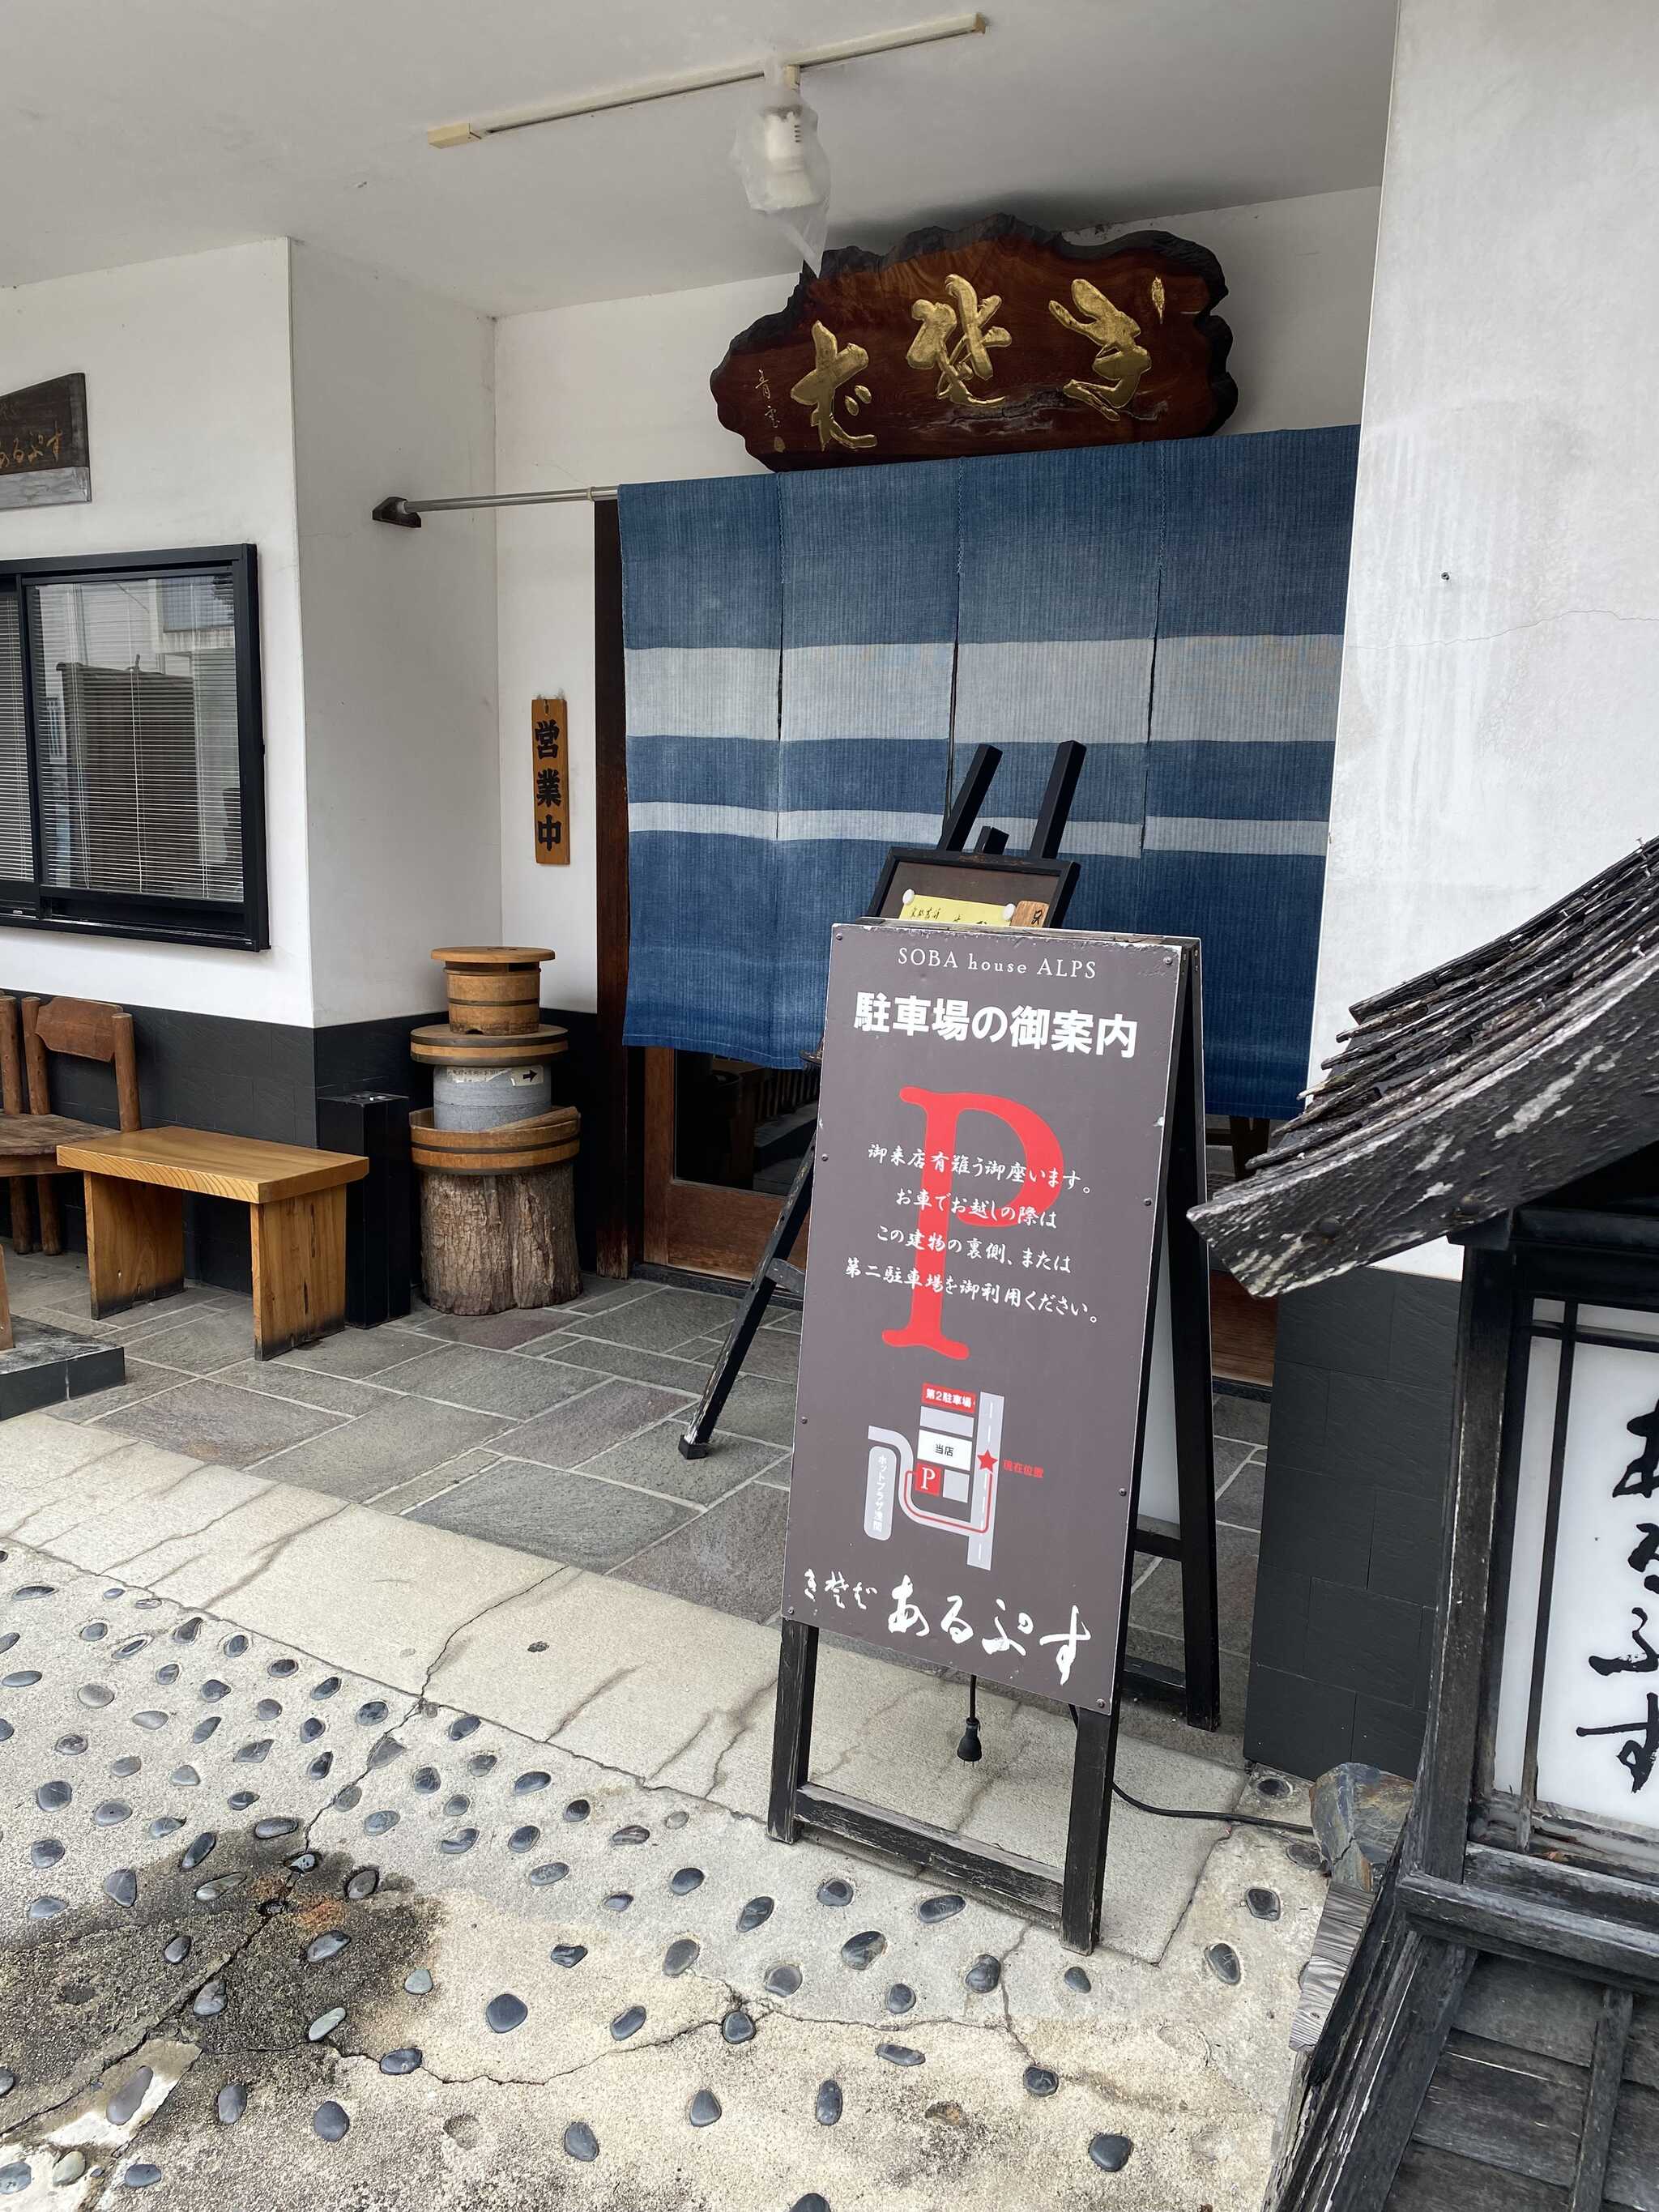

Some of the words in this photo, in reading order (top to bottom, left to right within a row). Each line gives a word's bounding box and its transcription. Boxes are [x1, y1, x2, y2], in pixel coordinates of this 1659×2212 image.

[535, 718, 561, 851] 営業中
[898, 948, 958, 969] SOBA
[968, 953, 1028, 974] house
[1038, 958, 1097, 978] ALPS
[853, 992, 1137, 1058] 駐車場の御案内
[868, 1144, 1090, 1194] 御来店有難う御座います。
[881, 1086, 1064, 1362] P
[896, 1187, 1057, 1229] お車でお越しの際は
[876, 1225, 1071, 1274] この建物の裏側、または
[843, 1256, 1097, 1323] 第二駐車場を御利用ください。
[935, 1443, 954, 1457] 当店
[921, 1467, 936, 1490] P
[888, 1574, 1091, 1685] あるぷす
